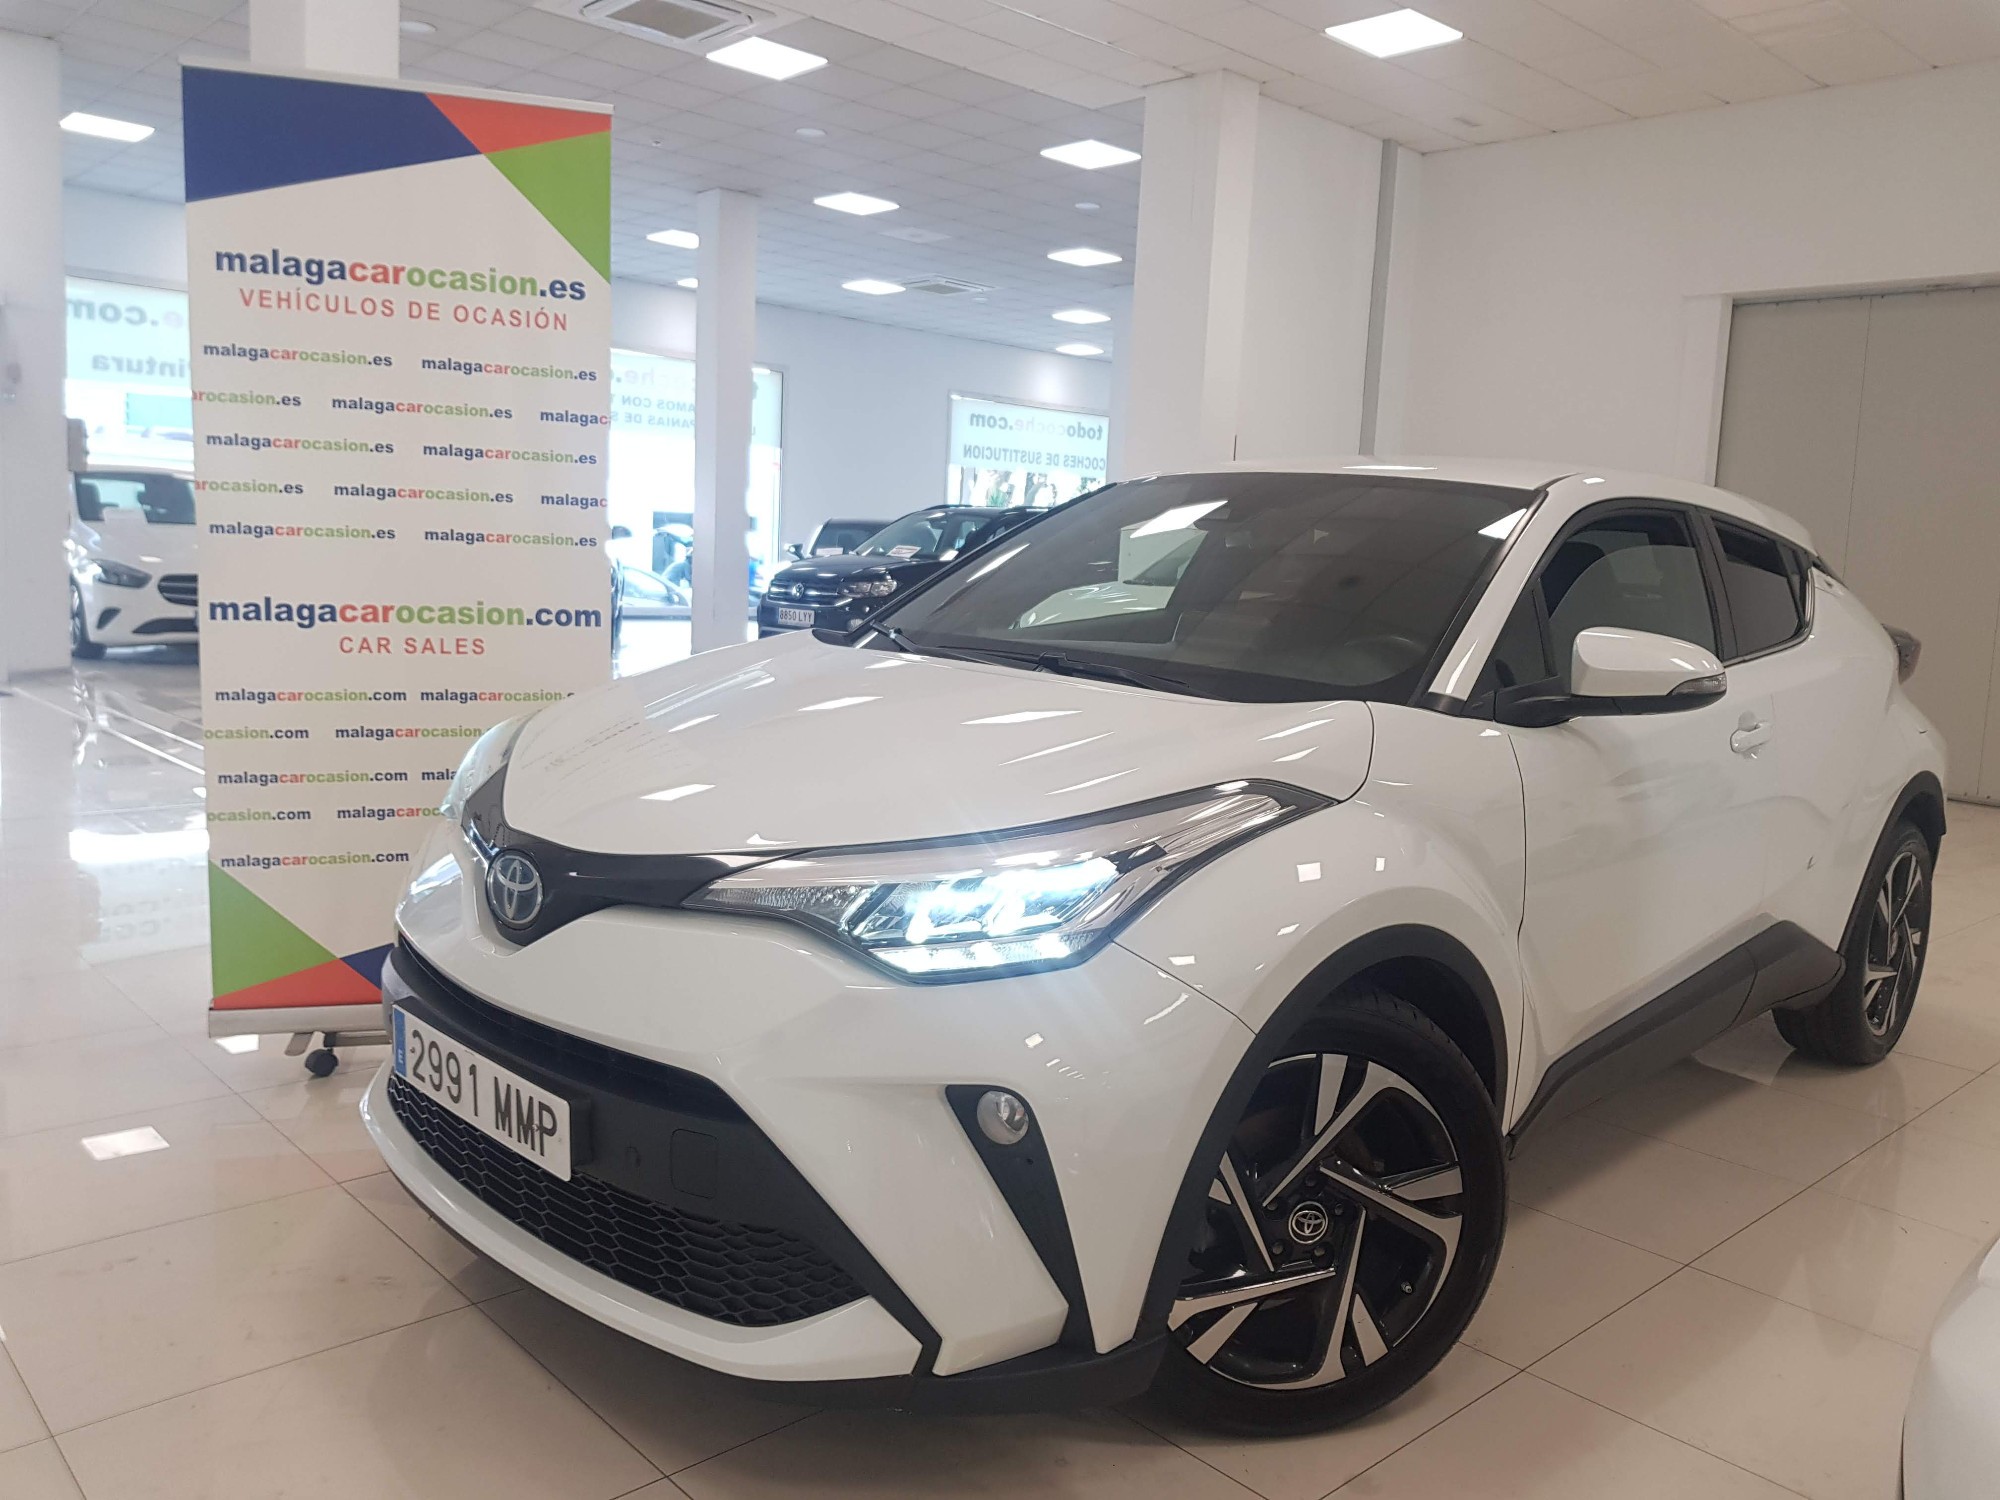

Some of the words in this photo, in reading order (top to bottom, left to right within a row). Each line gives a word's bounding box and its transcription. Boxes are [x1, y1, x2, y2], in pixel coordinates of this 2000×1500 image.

[215, 248, 586, 300] malagacarocasion.es
[239, 287, 394, 318] VEHÍCULOS
[409, 301, 440, 321] DE
[454, 304, 567, 331] OCASIÓN
[203, 342, 393, 367] malagacarocasion.es
[421, 357, 597, 382] malagacarocasion.es
[332, 398, 512, 418] malagacarocasion.es
[206, 431, 395, 454] malagacarocasion.es
[423, 443, 598, 465] malagacarocasion.es
[334, 484, 513, 503] malagacarocasion.es
[209, 521, 396, 540] malagacarocasion.es
[424, 528, 598, 547] malagacarocasion.es
[209, 596, 602, 629] malagacarocasion.com
[339, 637, 391, 655] CAR
[404, 637, 486, 655] SALES
[215, 688, 407, 705] malagacarocasion.com
[204, 726, 310, 740] ocasion.com
[218, 771, 409, 787] malagacarocasion.com
[221, 852, 409, 871] malagacarocasion.com
[412, 1029, 479, 1118] 2991
[494, 1075, 558, 1157] MMP
